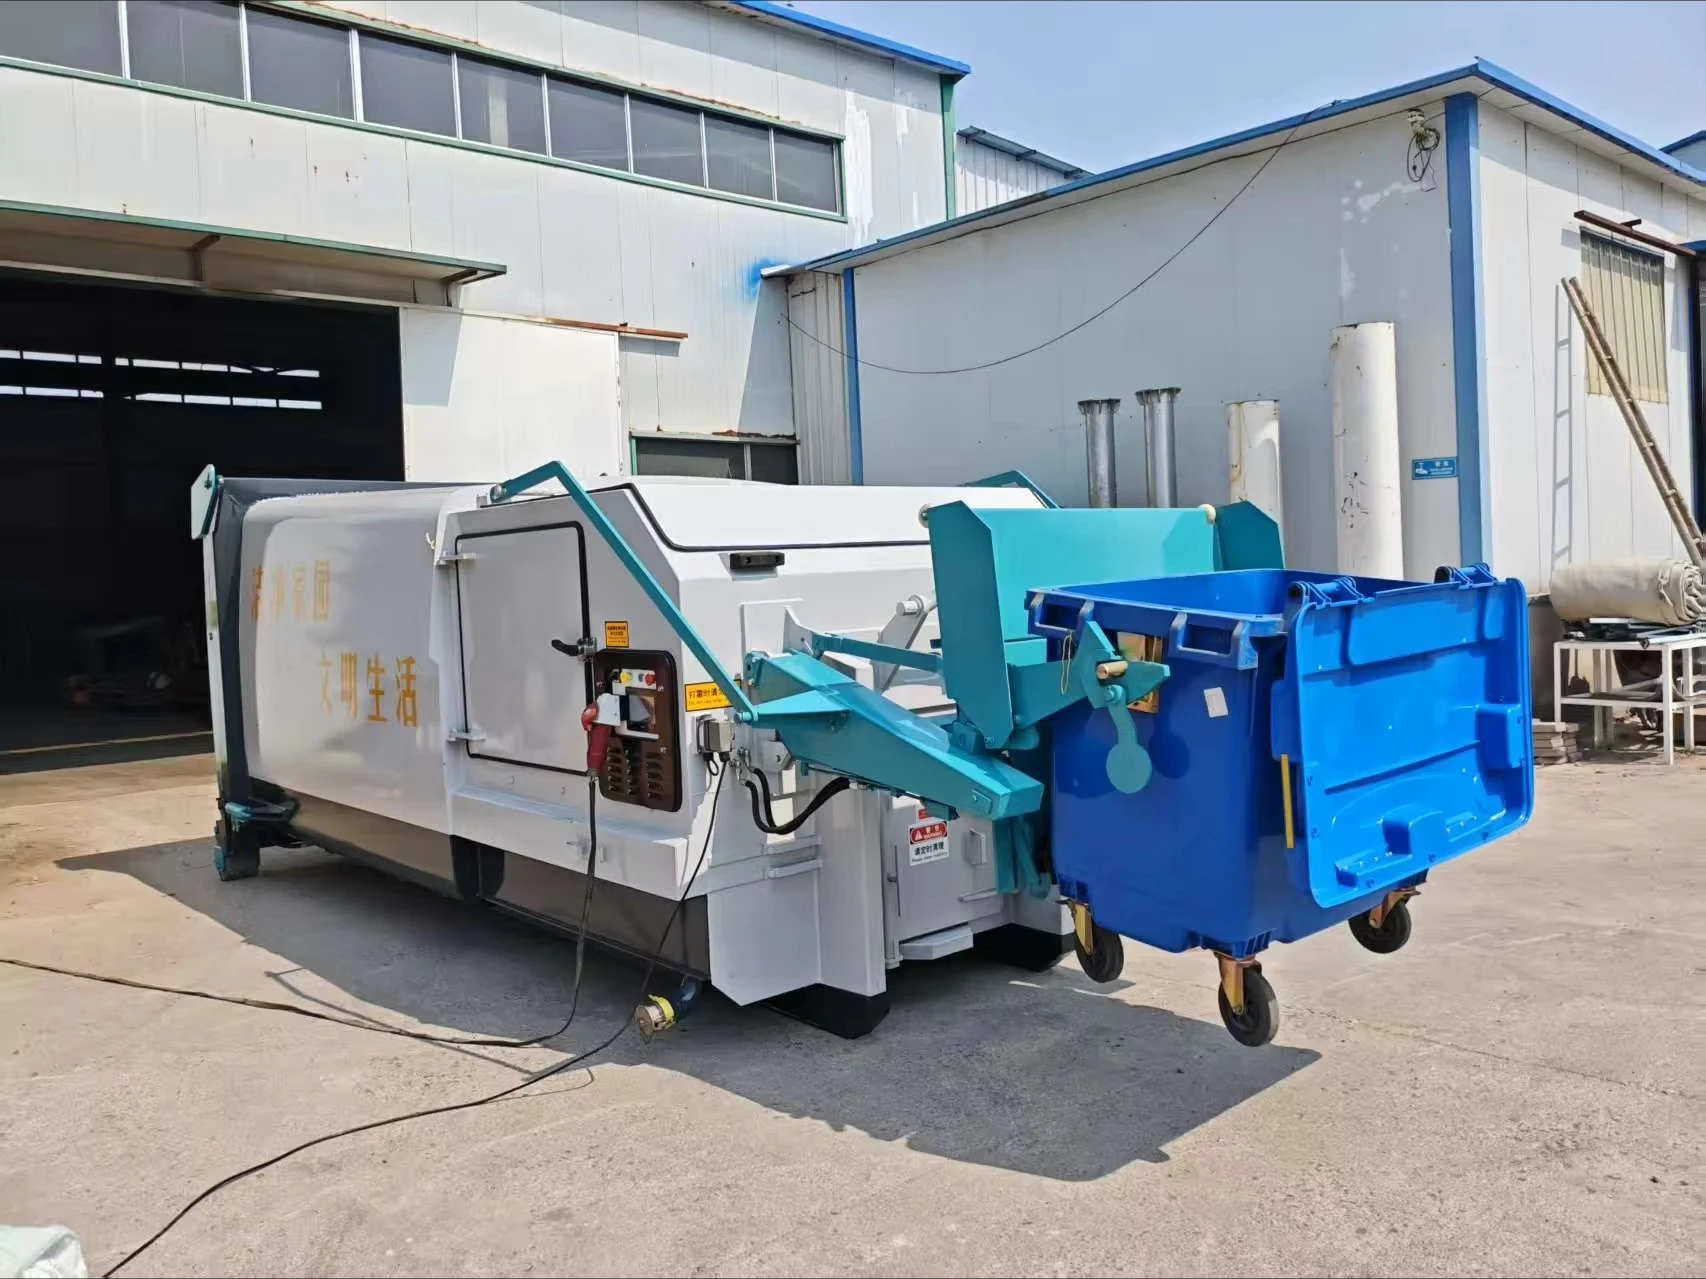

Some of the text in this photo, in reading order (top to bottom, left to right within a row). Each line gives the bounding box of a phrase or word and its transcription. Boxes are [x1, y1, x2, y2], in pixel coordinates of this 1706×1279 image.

[315, 651, 417, 727] 文明生活
[688, 688, 722, 699] 打雷时请
